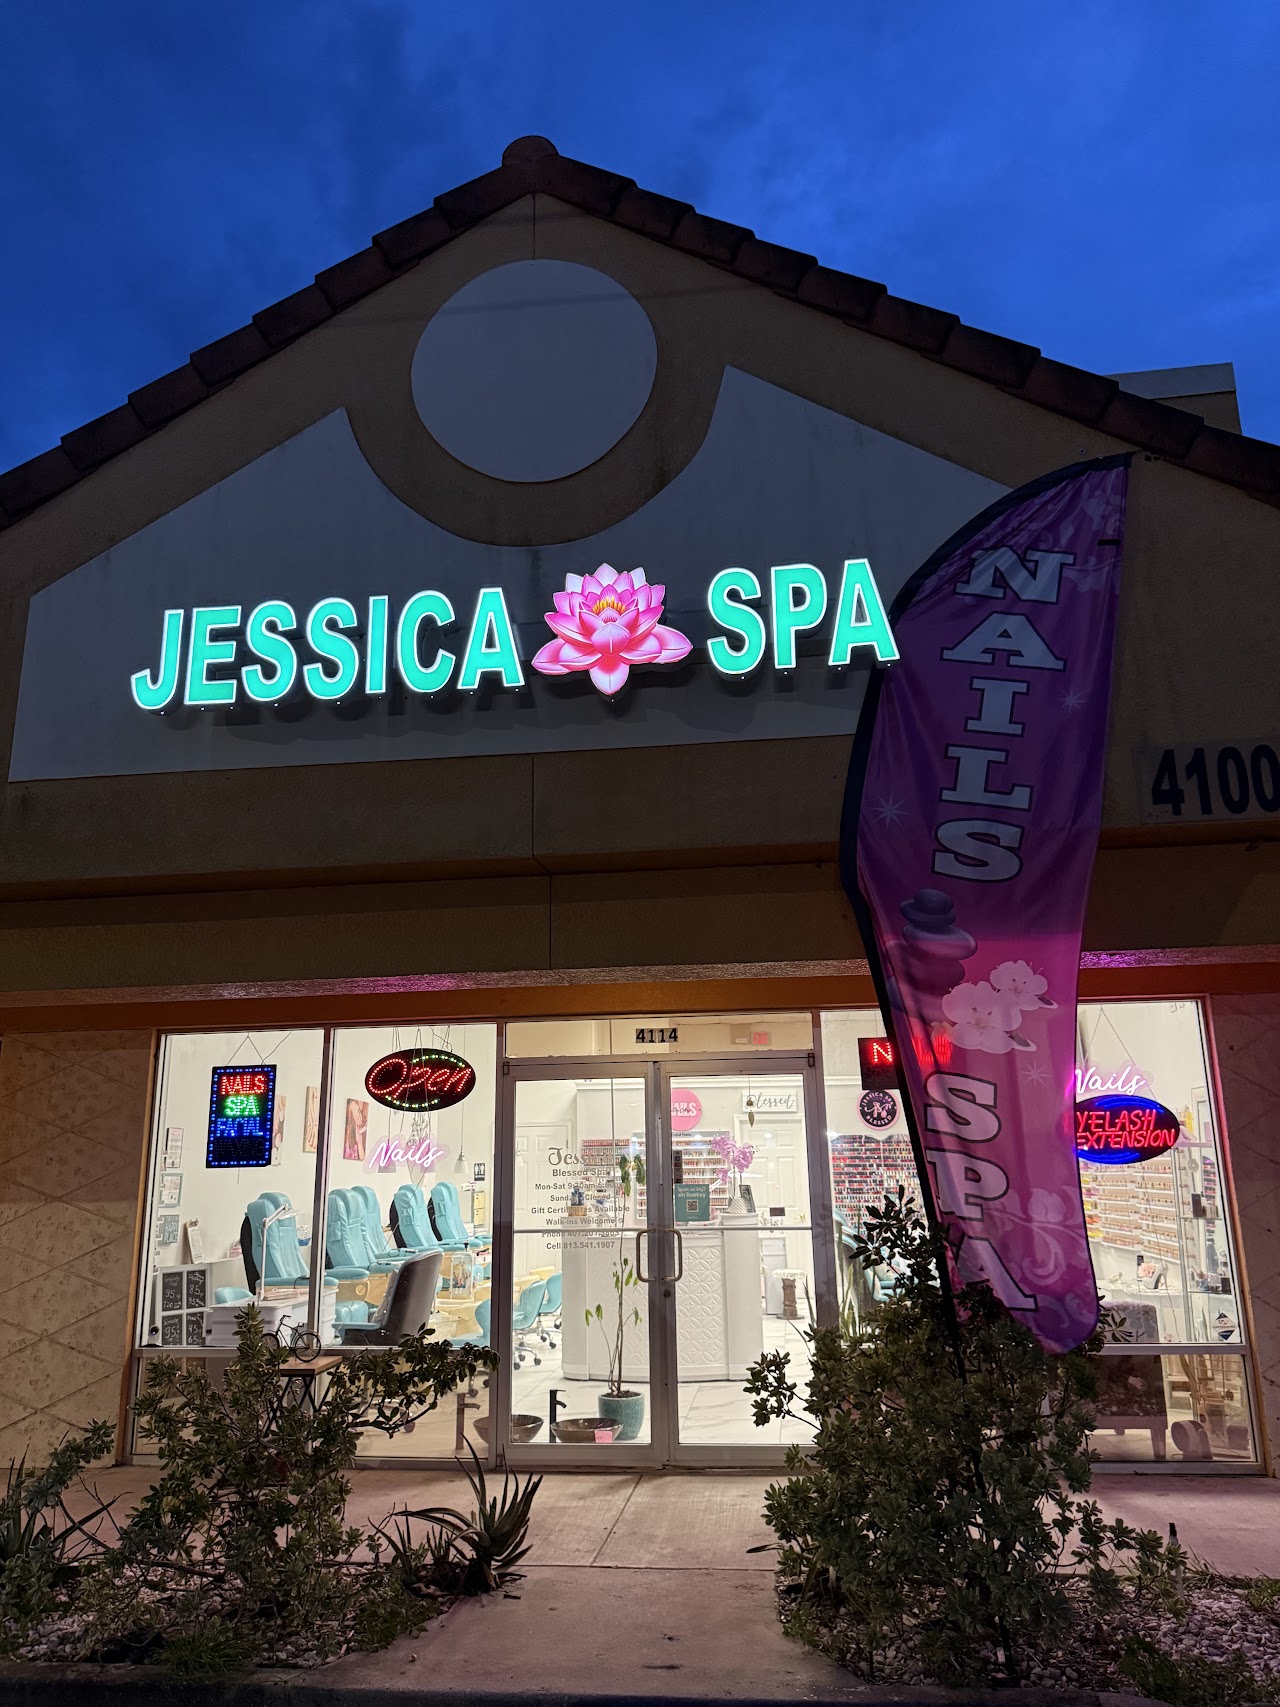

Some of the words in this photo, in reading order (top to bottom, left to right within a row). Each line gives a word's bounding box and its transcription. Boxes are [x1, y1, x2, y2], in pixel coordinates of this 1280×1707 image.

[131, 587, 526, 709] JESSICA
[707, 558, 900, 675] SPA
[931, 545, 1077, 883] NAILS
[1151, 744, 1280, 816] 4100
[635, 1028, 678, 1043] 4114
[221, 1075, 267, 1095] NAILS
[368, 1058, 472, 1098] Open
[224, 1095, 260, 1116] SPA
[866, 1115, 892, 1125] BLESSED
[1076, 1109, 1157, 1132] YELASH
[1077, 1129, 1176, 1149] EXTENSION
[369, 1139, 444, 1168] Nails
[552, 1168, 588, 1177] Blessed
[590, 1168, 609, 1178] Spa
[535, 1182, 565, 1190] Mon-Sat
[924, 1070, 1040, 1312] SPA
[585, 1193, 611, 1201] Closed
[545, 1218, 579, 1226] Walk-ins
[580, 1217, 616, 1225] Welcome
[546, 1242, 561, 1250] Cell
[563, 1241, 615, 1249] 813.541.1907
